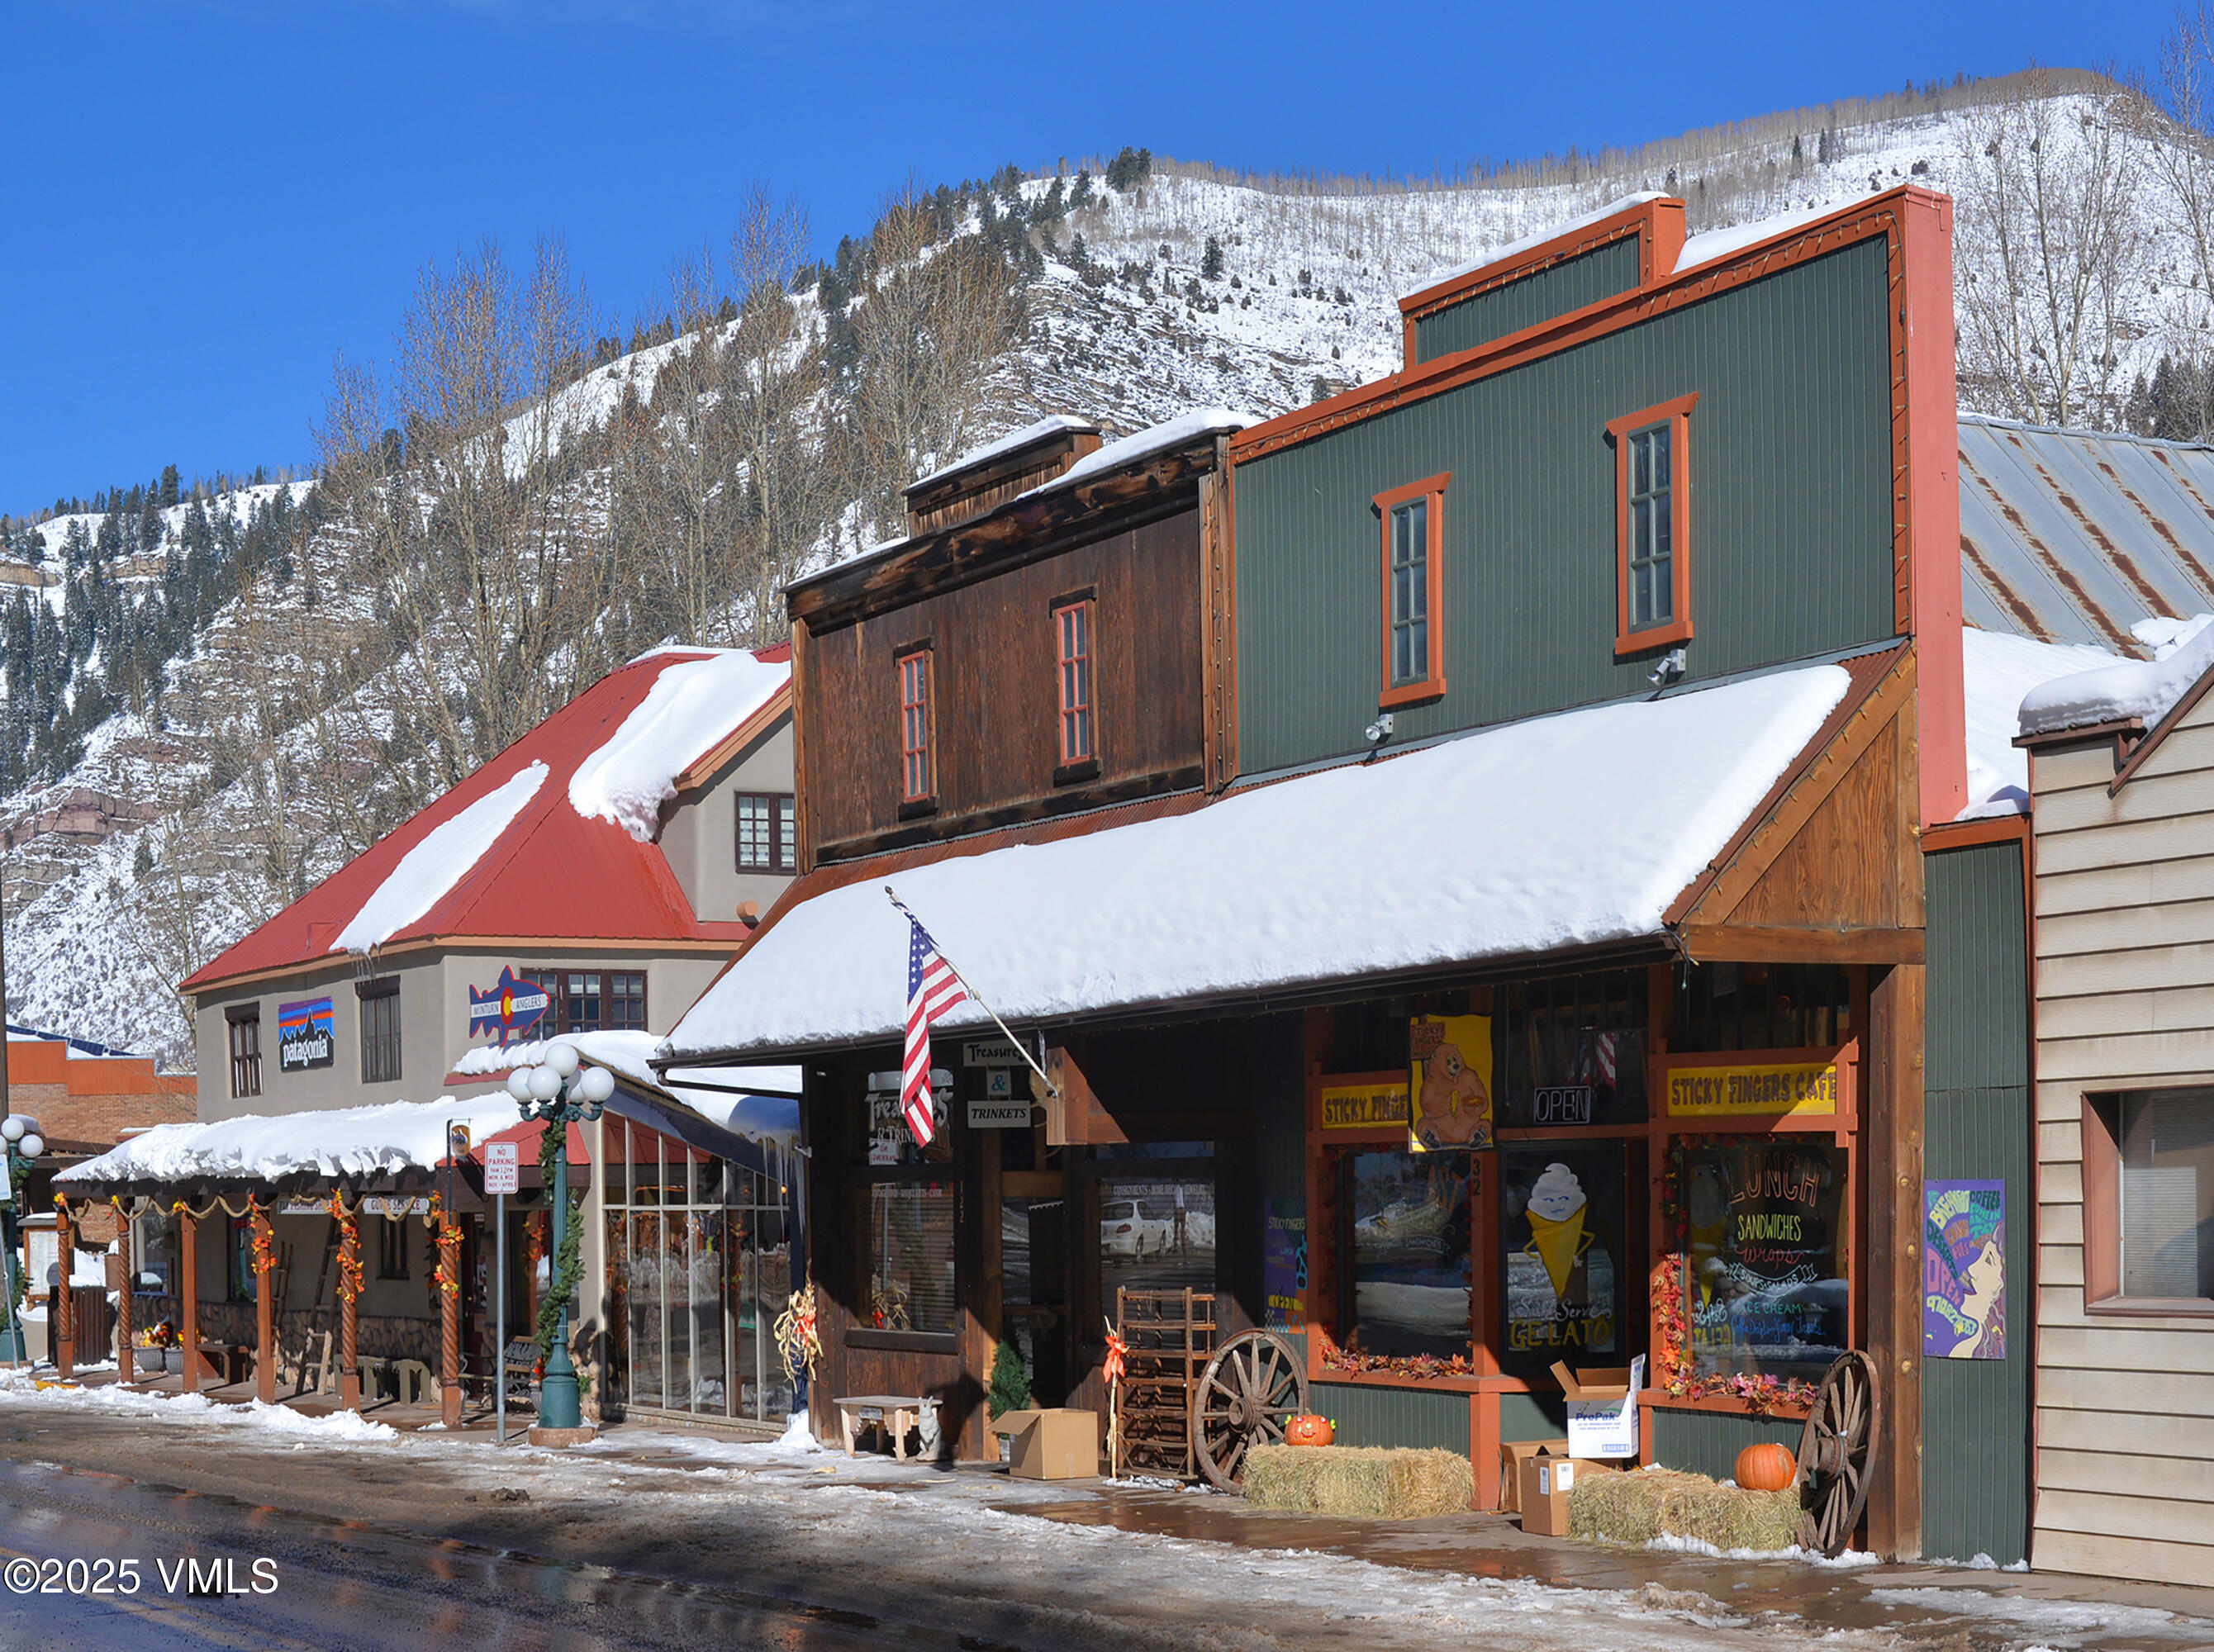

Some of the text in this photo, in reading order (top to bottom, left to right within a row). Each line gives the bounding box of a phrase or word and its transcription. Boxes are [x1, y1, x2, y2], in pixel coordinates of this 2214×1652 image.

[516, 996, 542, 1009] ANGLERS
[283, 1033, 328, 1067] patagonia
[967, 1042, 1028, 1062] Treasures
[991, 1074, 1005, 1091] &
[1671, 1070, 1836, 1105] STICKY FINGERS CAFE
[972, 1108, 1027, 1119] TRINKETS
[1324, 1094, 1409, 1123] STICKY FINGE
[1536, 1089, 1588, 1121] OPEN
[496, 1148, 506, 1156] NO
[1727, 1151, 1820, 1208] LUNCH
[1970, 1189, 2000, 1211] COFFEE
[1737, 1214, 1802, 1242] SANDWICHES
[1927, 1247, 1960, 1305] OPEN
[1554, 1298, 1612, 1322] Serve
[1763, 1303, 1802, 1315] CREAM
[1510, 1319, 1608, 1349] GELATO
[1575, 1412, 1616, 1422] ProPak
